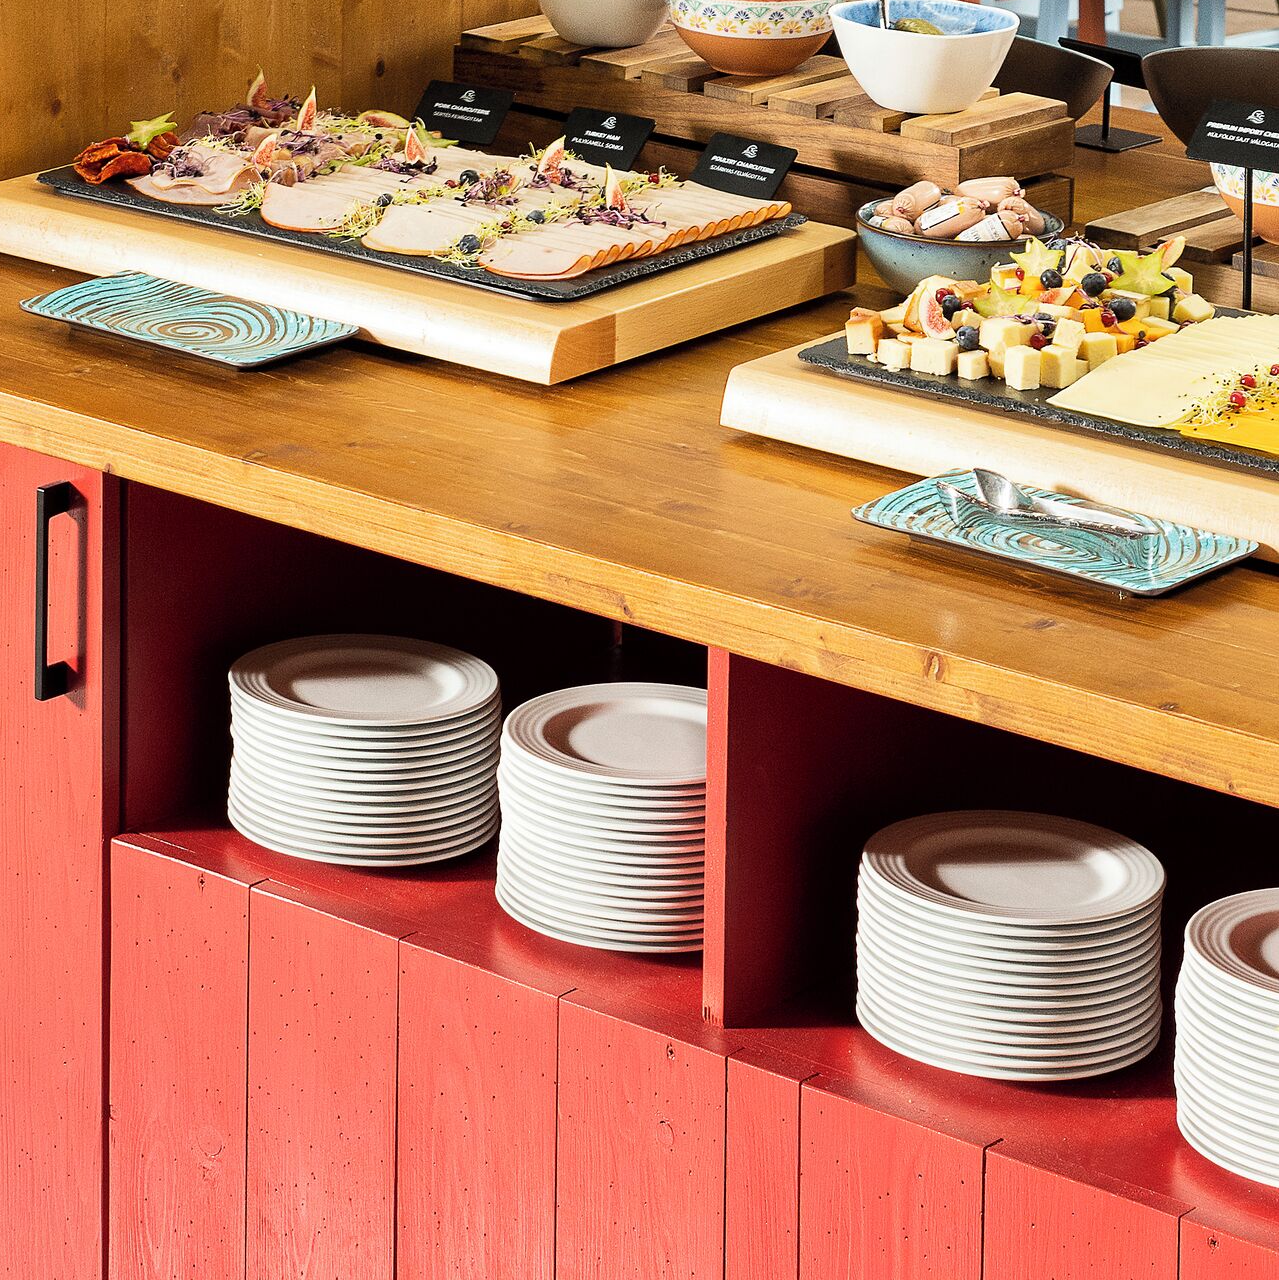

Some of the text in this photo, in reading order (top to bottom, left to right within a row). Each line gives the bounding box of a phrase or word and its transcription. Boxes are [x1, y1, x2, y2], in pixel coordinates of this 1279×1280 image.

[451, 104, 491, 116] CHARCUTERIE
[584, 130, 607, 139] TURKEY
[1205, 121, 1238, 132] PREMIUM
[1237, 126, 1265, 136] IMPORT
[604, 142, 624, 151] SONKA
[711, 155, 776, 174] POULTRY CHARCUTERIE
